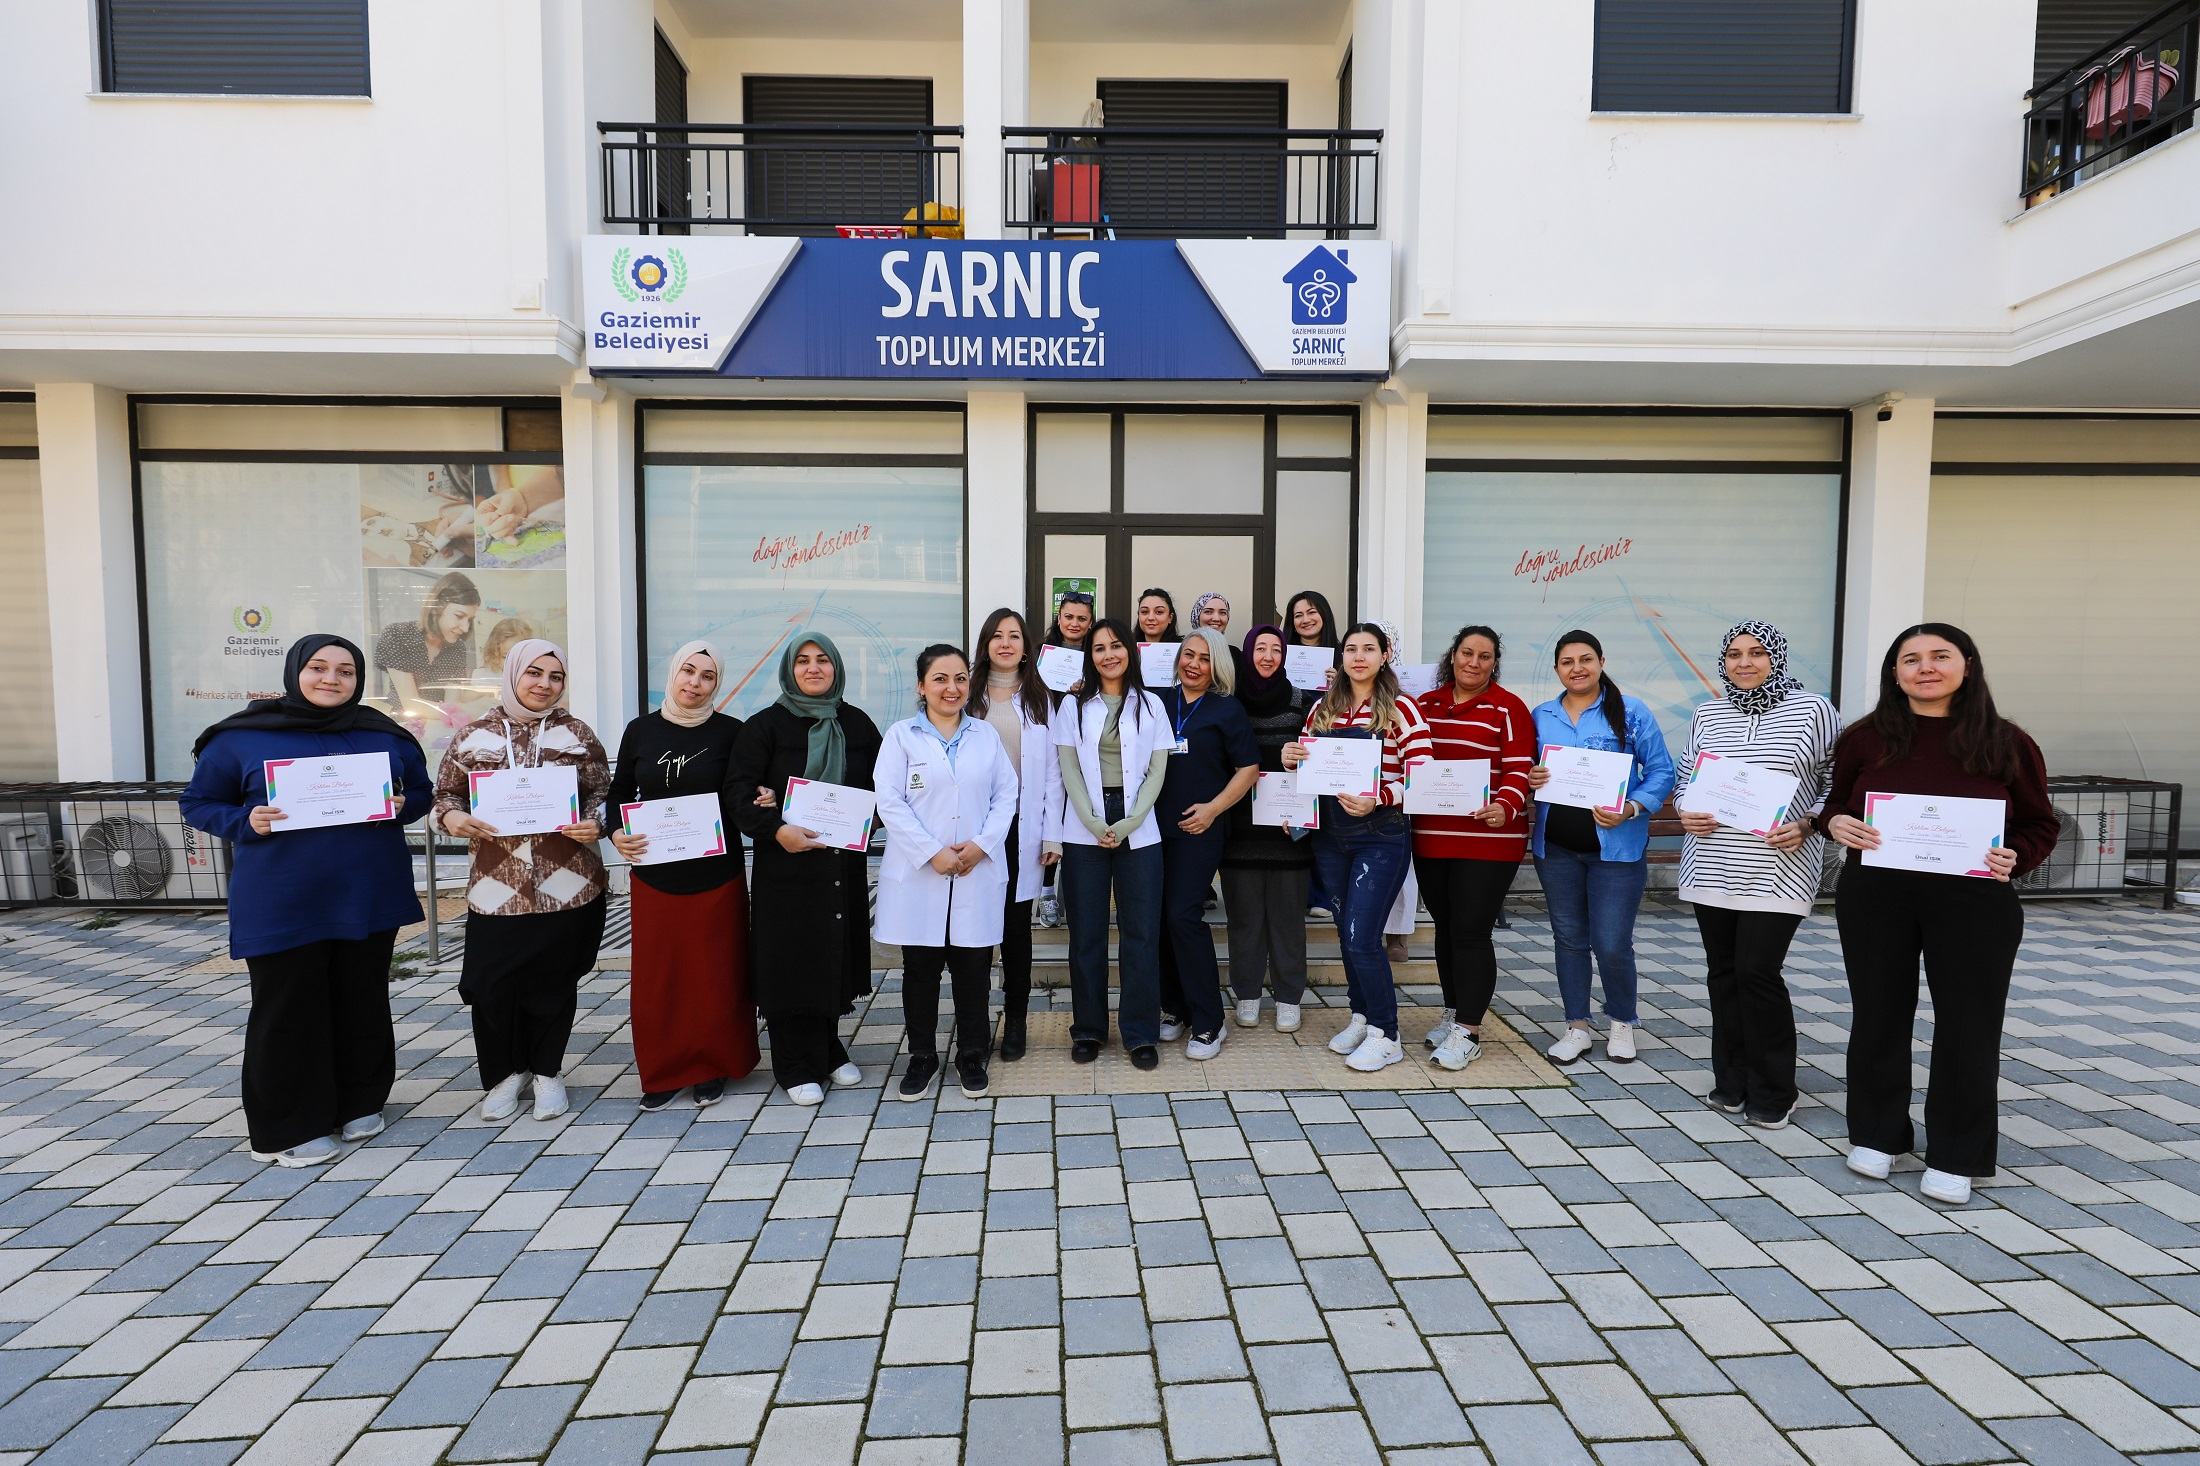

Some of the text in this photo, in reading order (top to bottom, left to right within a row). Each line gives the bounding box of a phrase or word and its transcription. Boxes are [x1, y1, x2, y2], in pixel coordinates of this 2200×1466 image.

[881, 250, 1100, 332] SARNIÇ
[600, 312, 700, 328] Gaziemir
[594, 332, 708, 353] Belediyesi
[876, 332, 1104, 366] TOPLUM MERKEZİ
[1292, 338, 1346, 357] SARNIÇ
[1292, 357, 1346, 366] TOPLUM MERKEZİ
[752, 536, 798, 570] doğru
[781, 523, 872, 590] yöndesiniz
[1514, 549, 1560, 583] doğru
[1542, 537, 1633, 603] yöndesiniz
[224, 646, 284, 658] Belediyesi
[227, 636, 280, 645] Gaziemir
